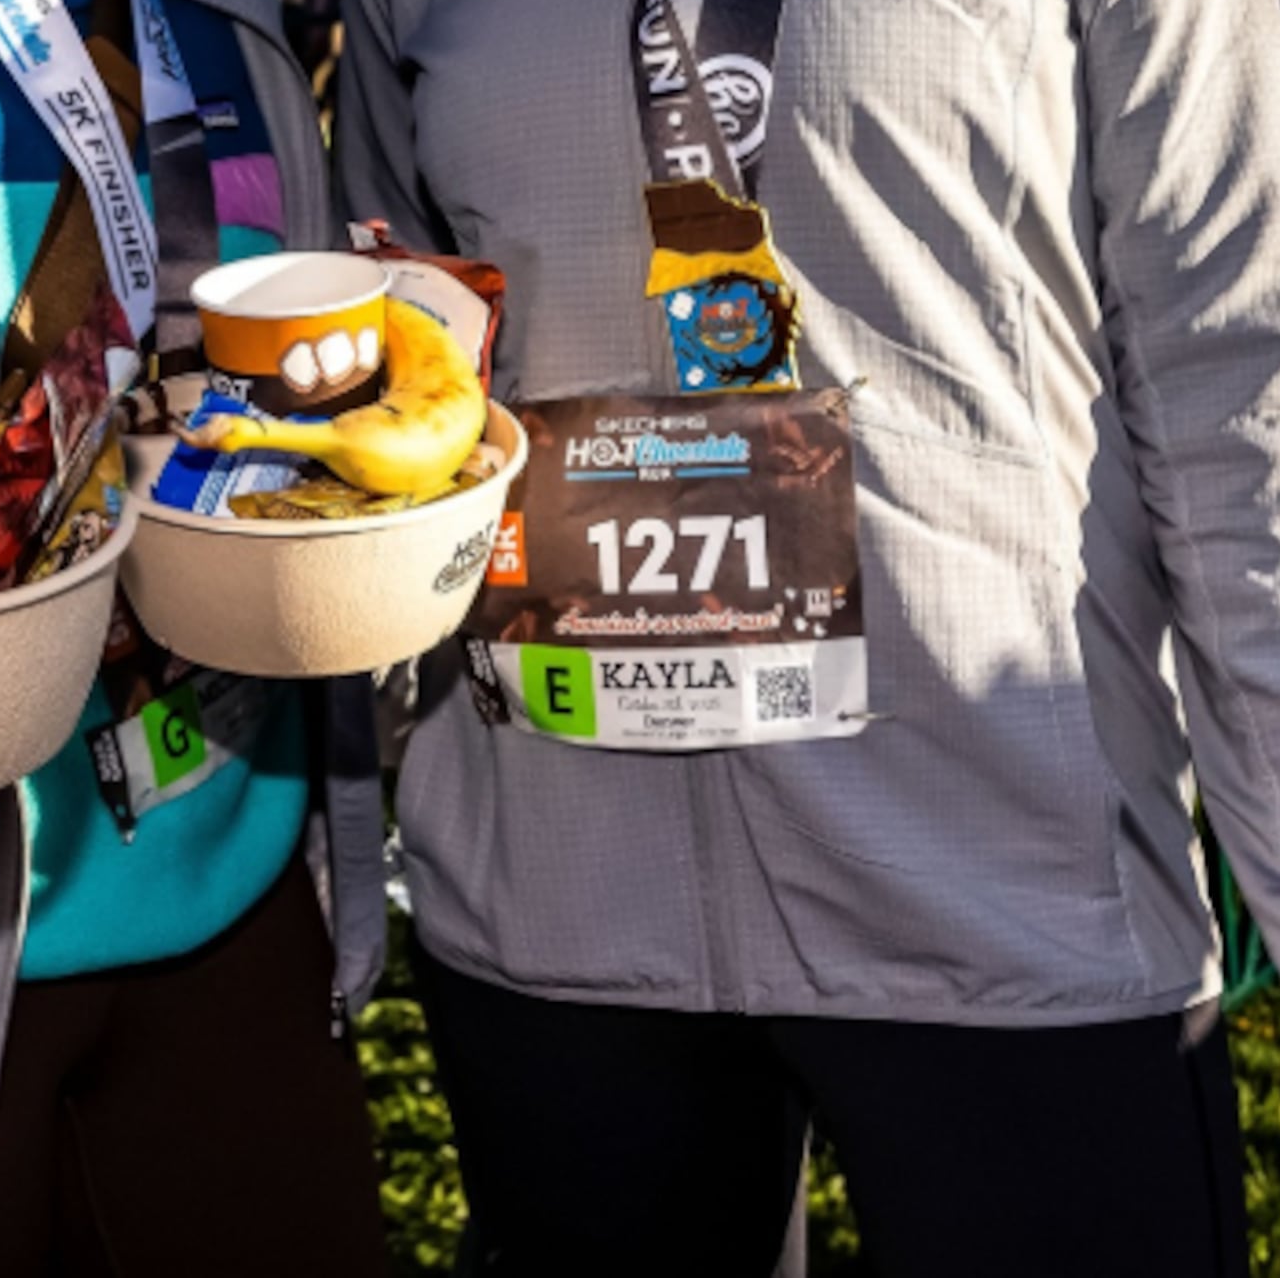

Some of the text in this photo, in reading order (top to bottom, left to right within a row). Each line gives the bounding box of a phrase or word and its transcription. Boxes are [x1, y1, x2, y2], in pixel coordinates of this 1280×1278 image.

[58, 87, 152, 293] 5K FINISHER
[565, 435, 637, 466] HOT
[493, 523, 520, 572] 5K
[587, 515, 770, 595] 1271
[545, 666, 574, 715] E
[600, 658, 736, 689] KAYLA
[162, 709, 190, 758] G
